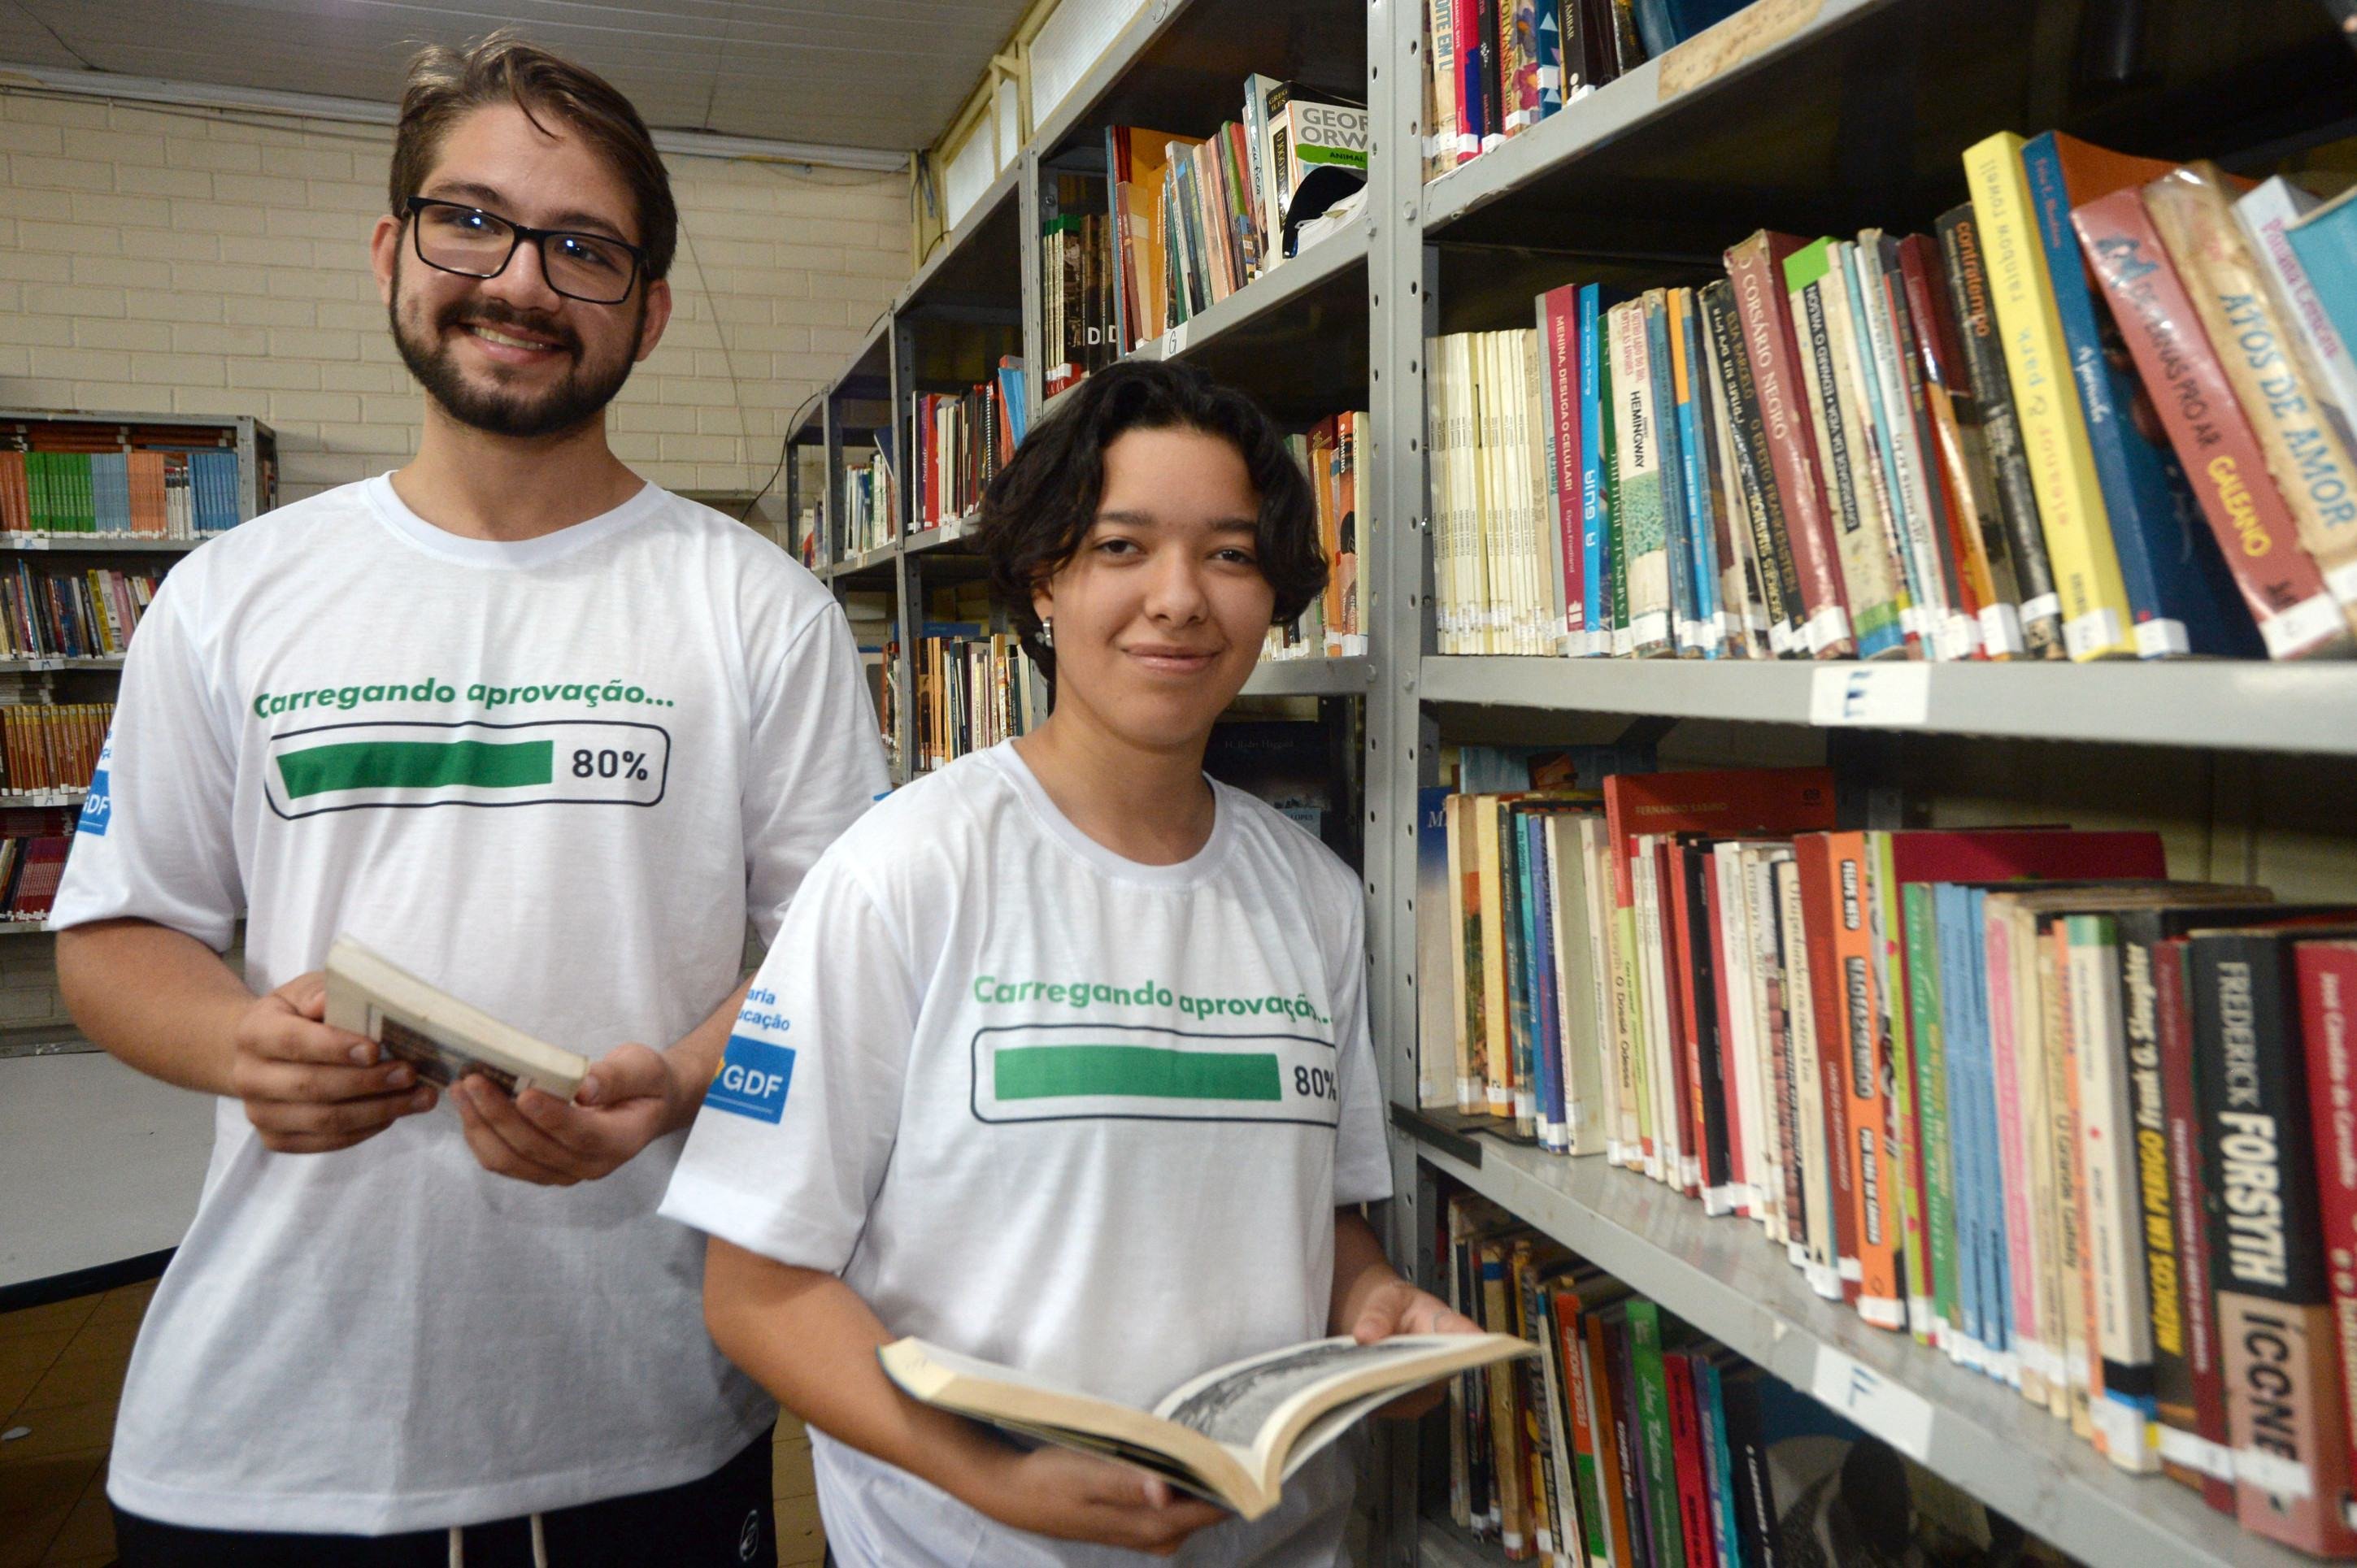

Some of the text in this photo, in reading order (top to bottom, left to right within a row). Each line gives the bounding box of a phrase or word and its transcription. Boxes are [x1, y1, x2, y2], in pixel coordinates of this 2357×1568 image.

[1436, 32, 1454, 58] EM
[1500, 0, 1513, 83] OLLYANNA
[1268, 89, 1288, 106] GREG
[1271, 98, 1286, 112] ILES
[1975, 156, 2008, 219] rowell
[1948, 219, 1996, 339] contratempo
[1989, 222, 2027, 304] rainbow
[1803, 284, 1825, 333] WILSON
[2214, 281, 2287, 375] ATOS
[1555, 314, 1567, 367] MENINA,
[1738, 271, 1777, 368] CORSÁRIO
[1759, 369, 1790, 441] NEGRO
[1813, 345, 1837, 397] EDWARD
[2011, 324, 2046, 389] park
[1558, 367, 1570, 420] DESLIGA
[1824, 402, 1842, 433] VIDA
[2255, 365, 2310, 426] DE
[1560, 421, 1570, 432] O
[1629, 389, 1646, 469] HEMINGWAY
[1829, 432, 1846, 453] DA
[1546, 434, 1559, 496] Esmeralda
[1561, 432, 1573, 491] CELULAR!
[1832, 451, 1859, 529] DIVERSIDADE
[2035, 424, 2072, 528] eleanor
[2277, 415, 2357, 534] AMOR
[1584, 467, 1596, 520] GUIA
[2202, 450, 2277, 564] GALEANO
[1585, 530, 1596, 547] A
[254, 678, 674, 719] Carregando aprovação...
[572, 749, 648, 781] 80%
[1841, 861, 1861, 930] FELIPE NETO
[973, 975, 1172, 1009] Carregando
[2120, 940, 2160, 1044] Slaughter
[1614, 974, 1624, 988] O
[1619, 1038, 1633, 1089] Odessa
[723, 1064, 783, 1099] GDF
[1294, 1065, 1337, 1101] 80%
[2131, 1068, 2163, 1131] Frank
[2216, 959, 2286, 1292] FREDERICK FORSYTH
